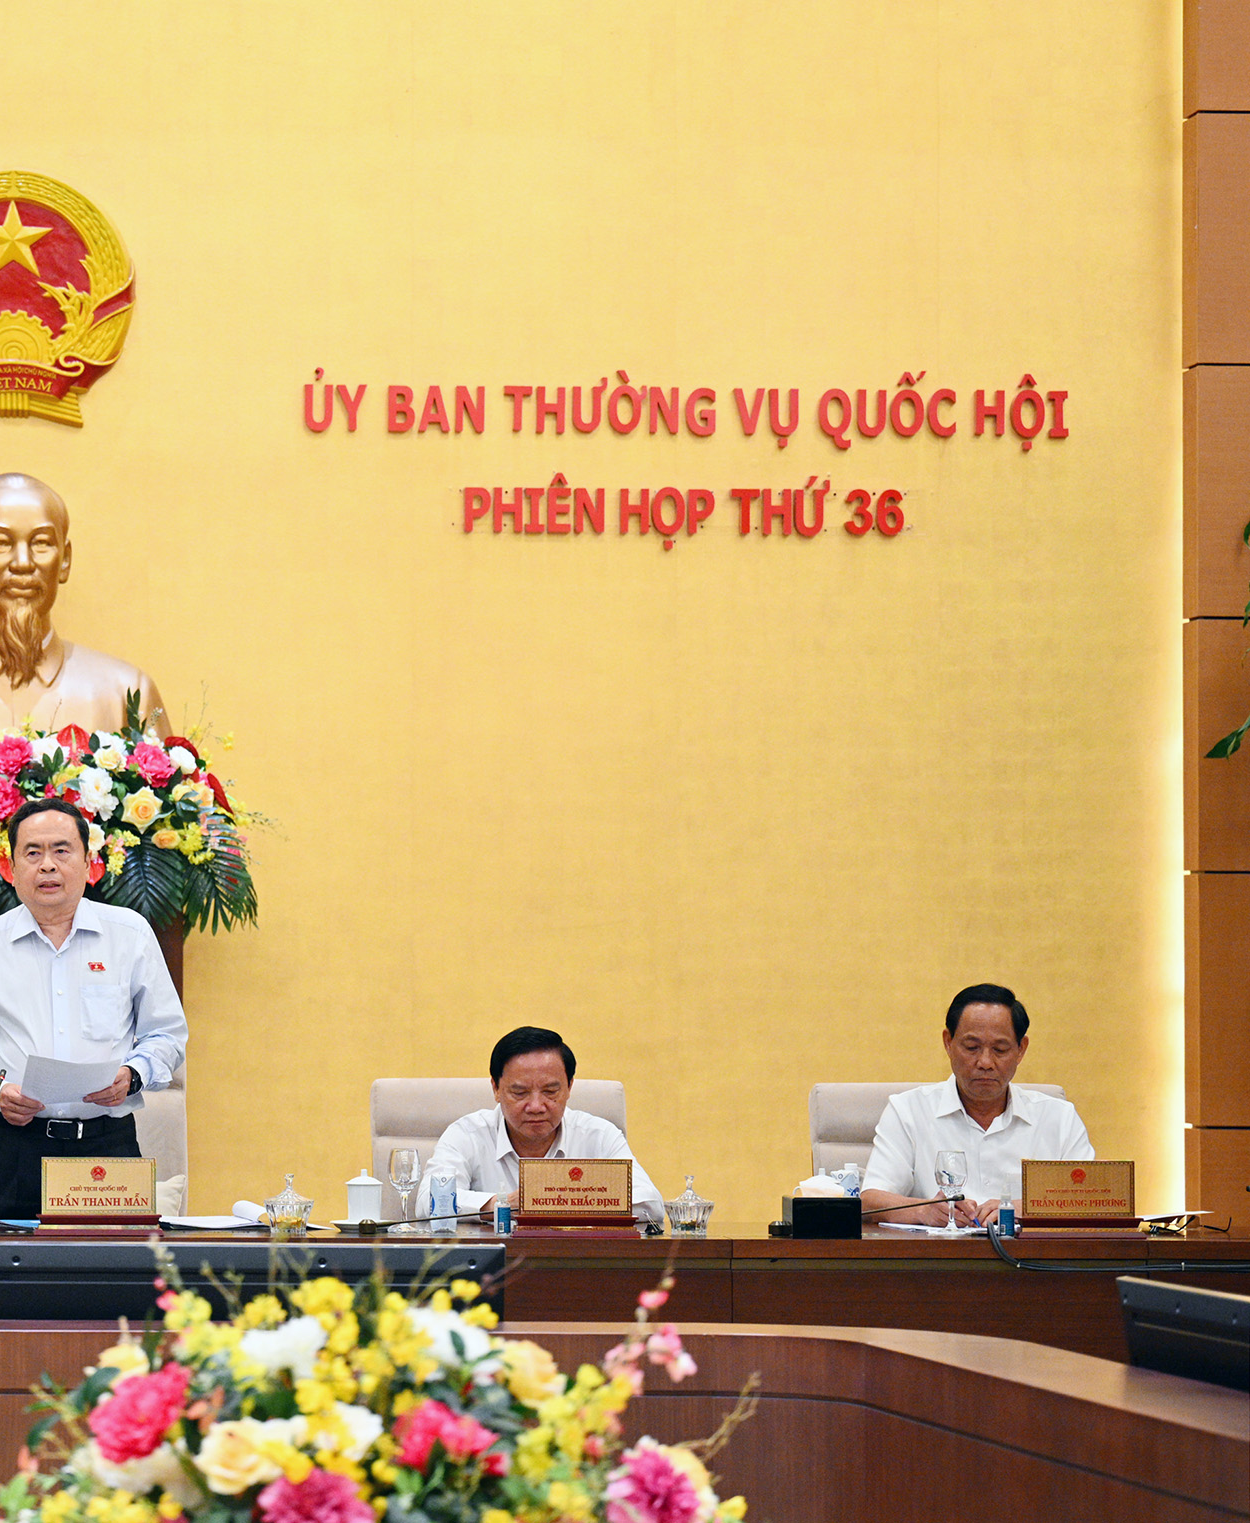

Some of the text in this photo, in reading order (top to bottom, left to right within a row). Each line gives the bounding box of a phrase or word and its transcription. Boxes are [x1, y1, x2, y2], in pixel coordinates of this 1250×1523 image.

[14, 377, 53, 393] NAM
[304, 367, 1070, 452] ỦY BAN THƯỜNG VỤ QUỐC HỘI
[463, 472, 905, 551] PHIÊN HỌP THỨ 36
[49, 1192, 149, 1206] TRẦN THANH MẪN
[531, 1194, 620, 1208] NGUYỄN KHẮC ĐỊNH
[1056, 1199, 1087, 1208] QUANG
[1089, 1198, 1126, 1207] PHƯƠNG
